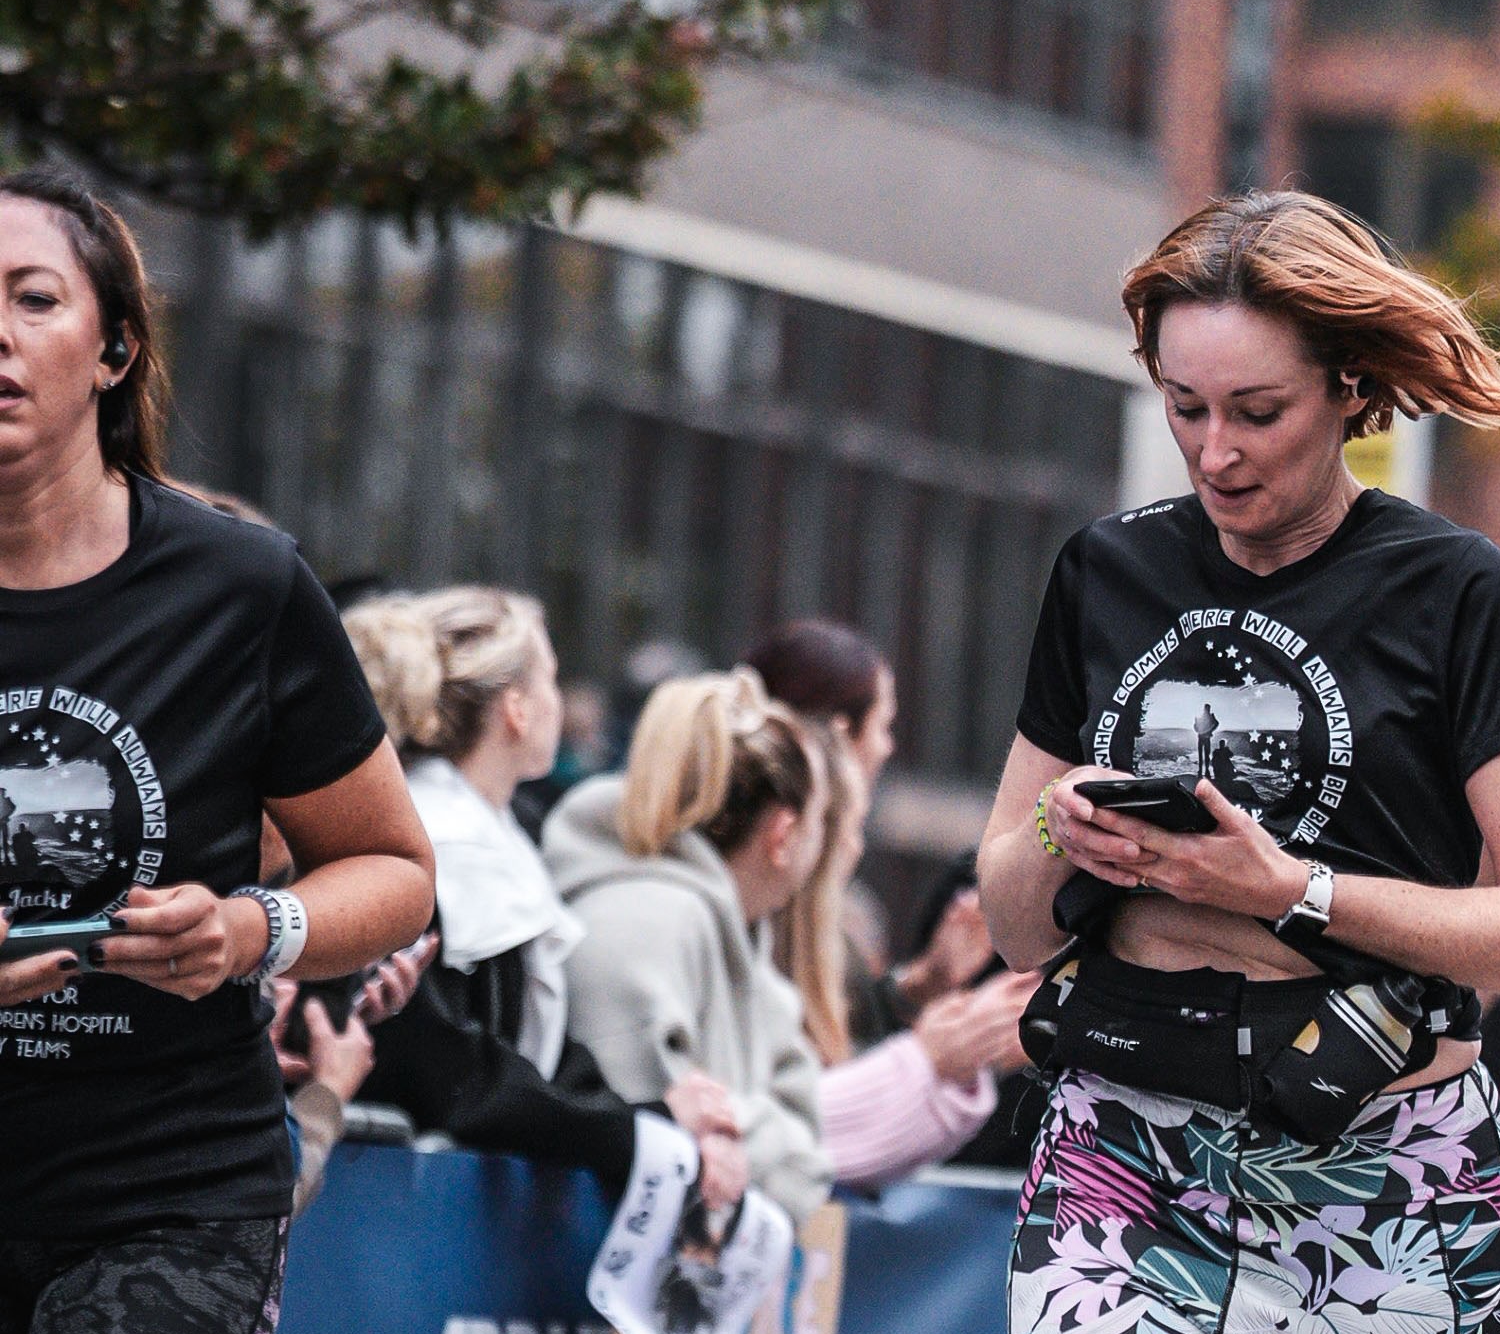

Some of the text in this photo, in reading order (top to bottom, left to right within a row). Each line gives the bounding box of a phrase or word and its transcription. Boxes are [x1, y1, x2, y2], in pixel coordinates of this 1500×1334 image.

[1138, 503, 1174, 518] JAKO
[1178, 608, 1236, 639] HERE
[1241, 609, 1308, 660] WILL
[1113, 627, 1180, 706] COMES
[49, 686, 121, 735] WILL
[1301, 655, 1353, 767] ALWAYS
[1094, 710, 1120, 769] WHO
[112, 723, 167, 839] ALWAYS
[1318, 774, 1348, 809] BE
[133, 850, 163, 885] BE
[0, 1011, 135, 1034] RENS HOSPITAL
[15, 1037, 72, 1060] TEAMS
